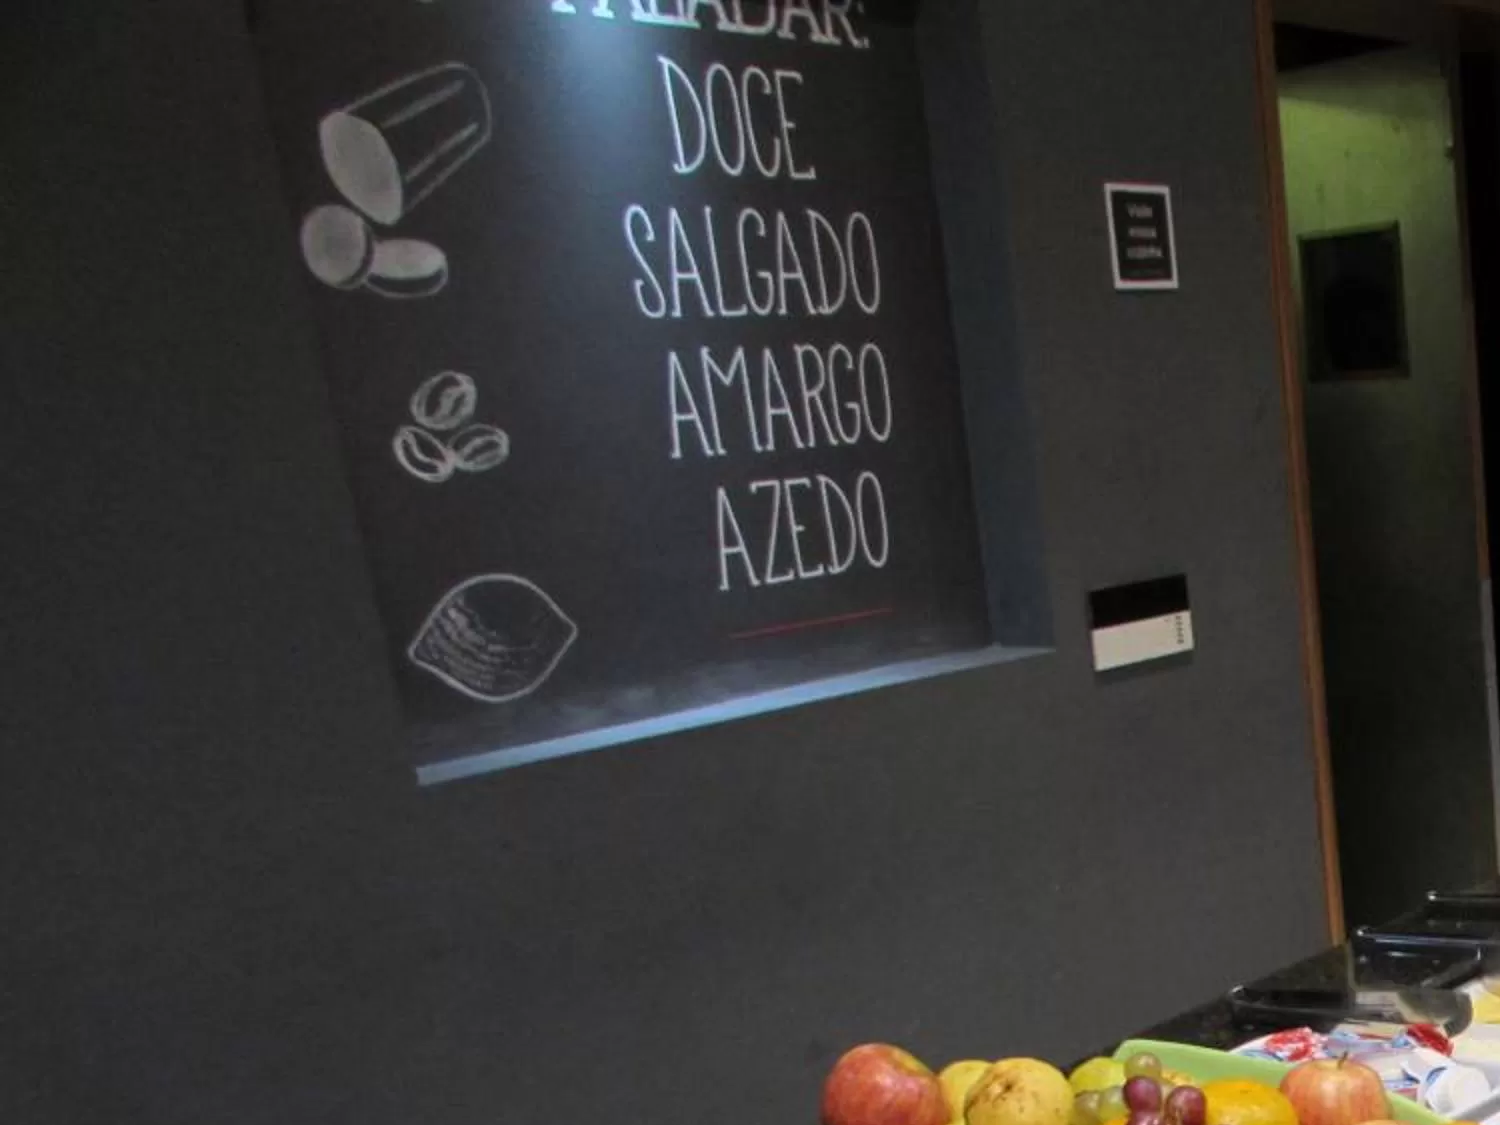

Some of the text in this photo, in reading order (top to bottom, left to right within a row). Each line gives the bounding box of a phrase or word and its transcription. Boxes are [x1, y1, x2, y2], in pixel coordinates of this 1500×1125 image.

[656, 54, 816, 180] DOCE
[622, 204, 882, 319] SALGADO
[668, 342, 893, 461] AMARGO
[717, 470, 890, 592] AZEDO
